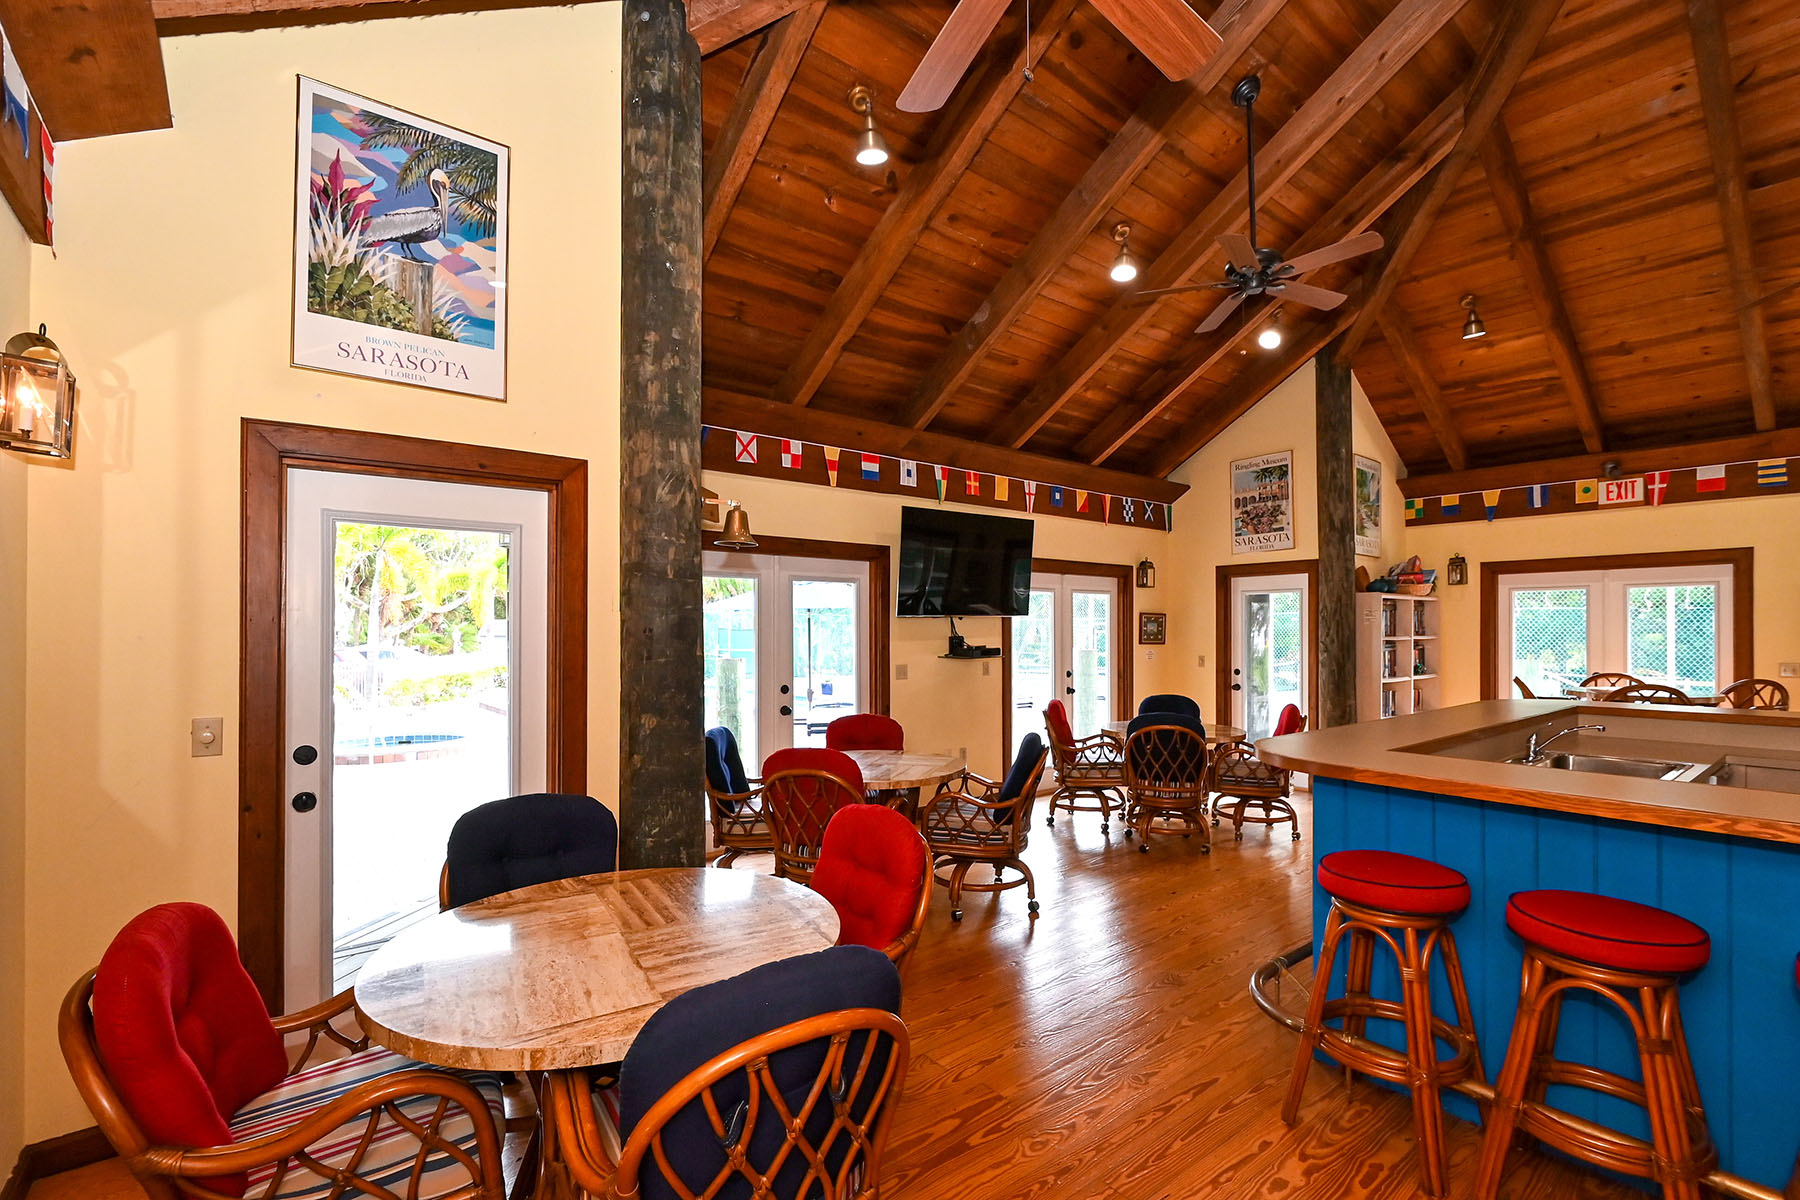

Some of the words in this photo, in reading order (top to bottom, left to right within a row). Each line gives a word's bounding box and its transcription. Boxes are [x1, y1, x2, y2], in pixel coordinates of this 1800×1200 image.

[365, 336, 400, 348] BROWN
[404, 343, 445, 357] PELICAN
[337, 341, 470, 380] SARASOTA
[384, 368, 427, 382] FLORIDA
[1261, 457, 1288, 466] Museum
[1606, 480, 1637, 501] EXIT
[1235, 532, 1290, 547] SARASOTA
